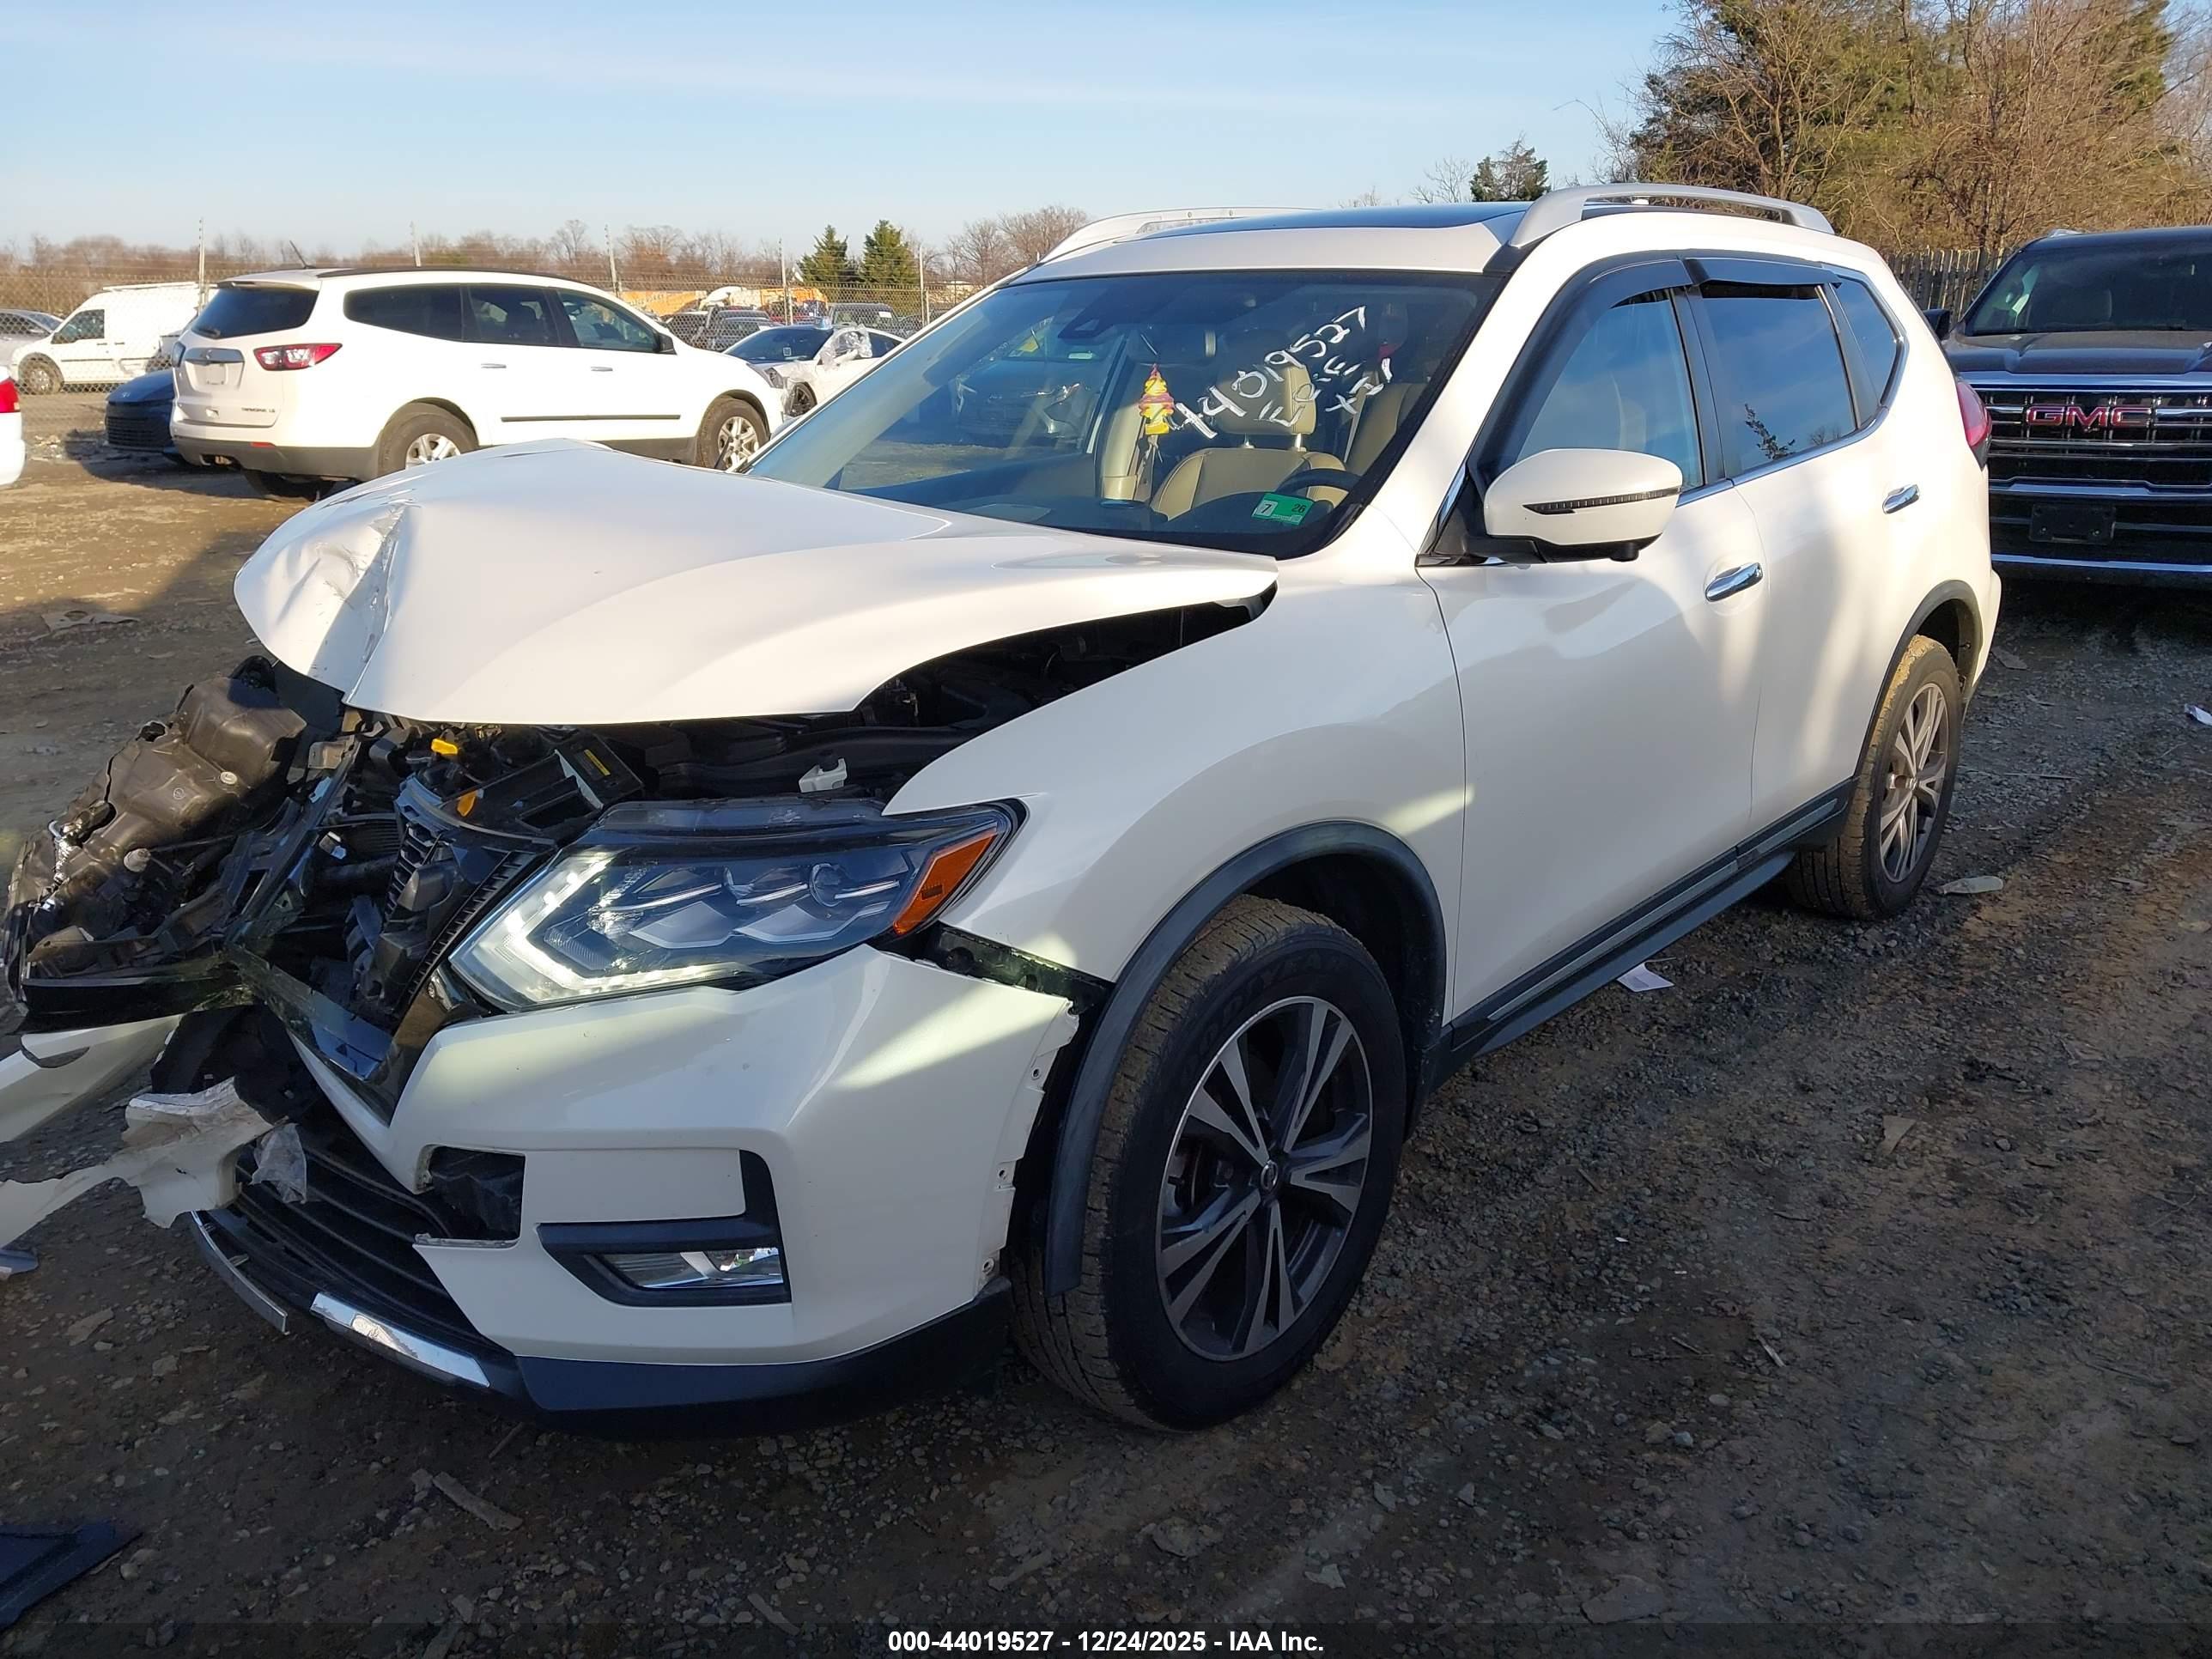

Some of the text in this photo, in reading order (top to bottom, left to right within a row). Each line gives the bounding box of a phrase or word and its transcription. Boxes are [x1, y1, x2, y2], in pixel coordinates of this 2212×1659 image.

[2027, 405, 2151, 427] GMC
[1261, 503, 1273, 514] 7
[1291, 503, 1307, 514] 26
